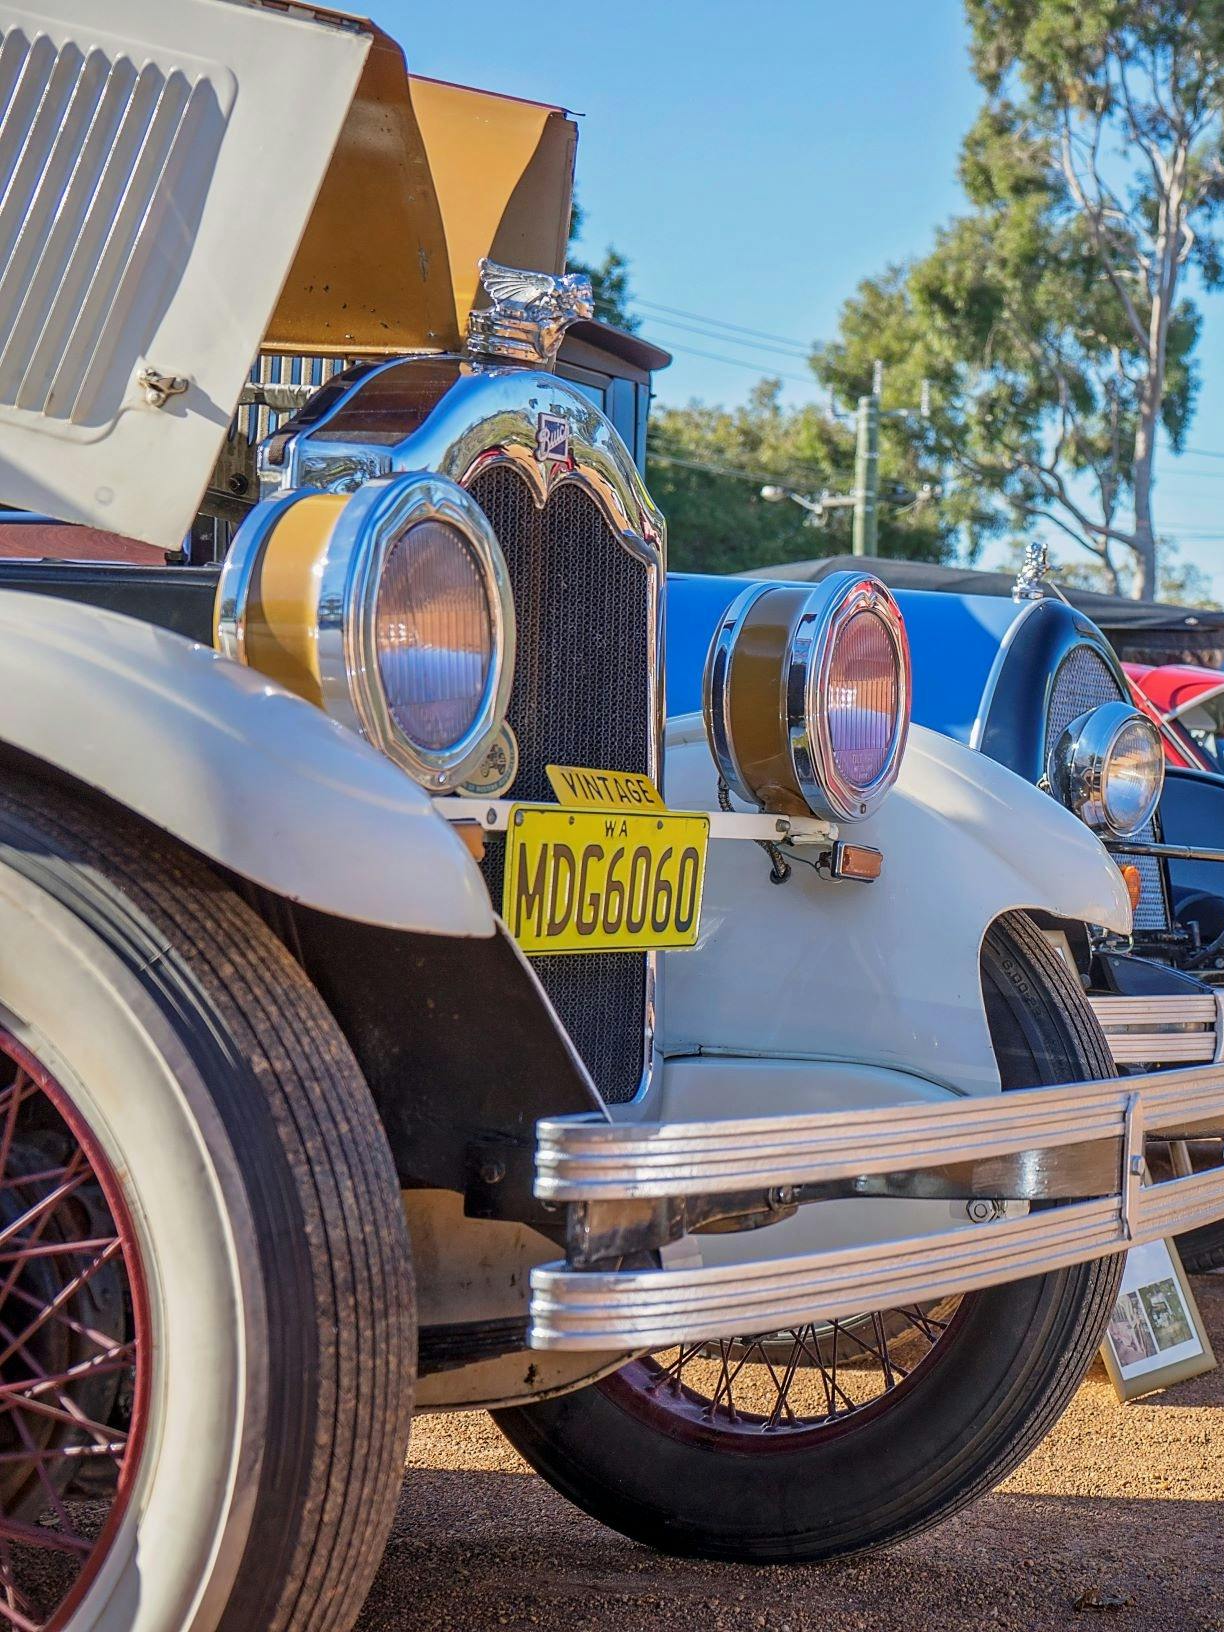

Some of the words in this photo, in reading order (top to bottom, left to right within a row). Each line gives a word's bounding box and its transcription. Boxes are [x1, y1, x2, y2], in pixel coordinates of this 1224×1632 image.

[535, 423, 568, 462] Buic
[561, 772, 655, 804] VINTAGE
[604, 820, 628, 838] WA
[514, 842, 700, 939] MDG6060
